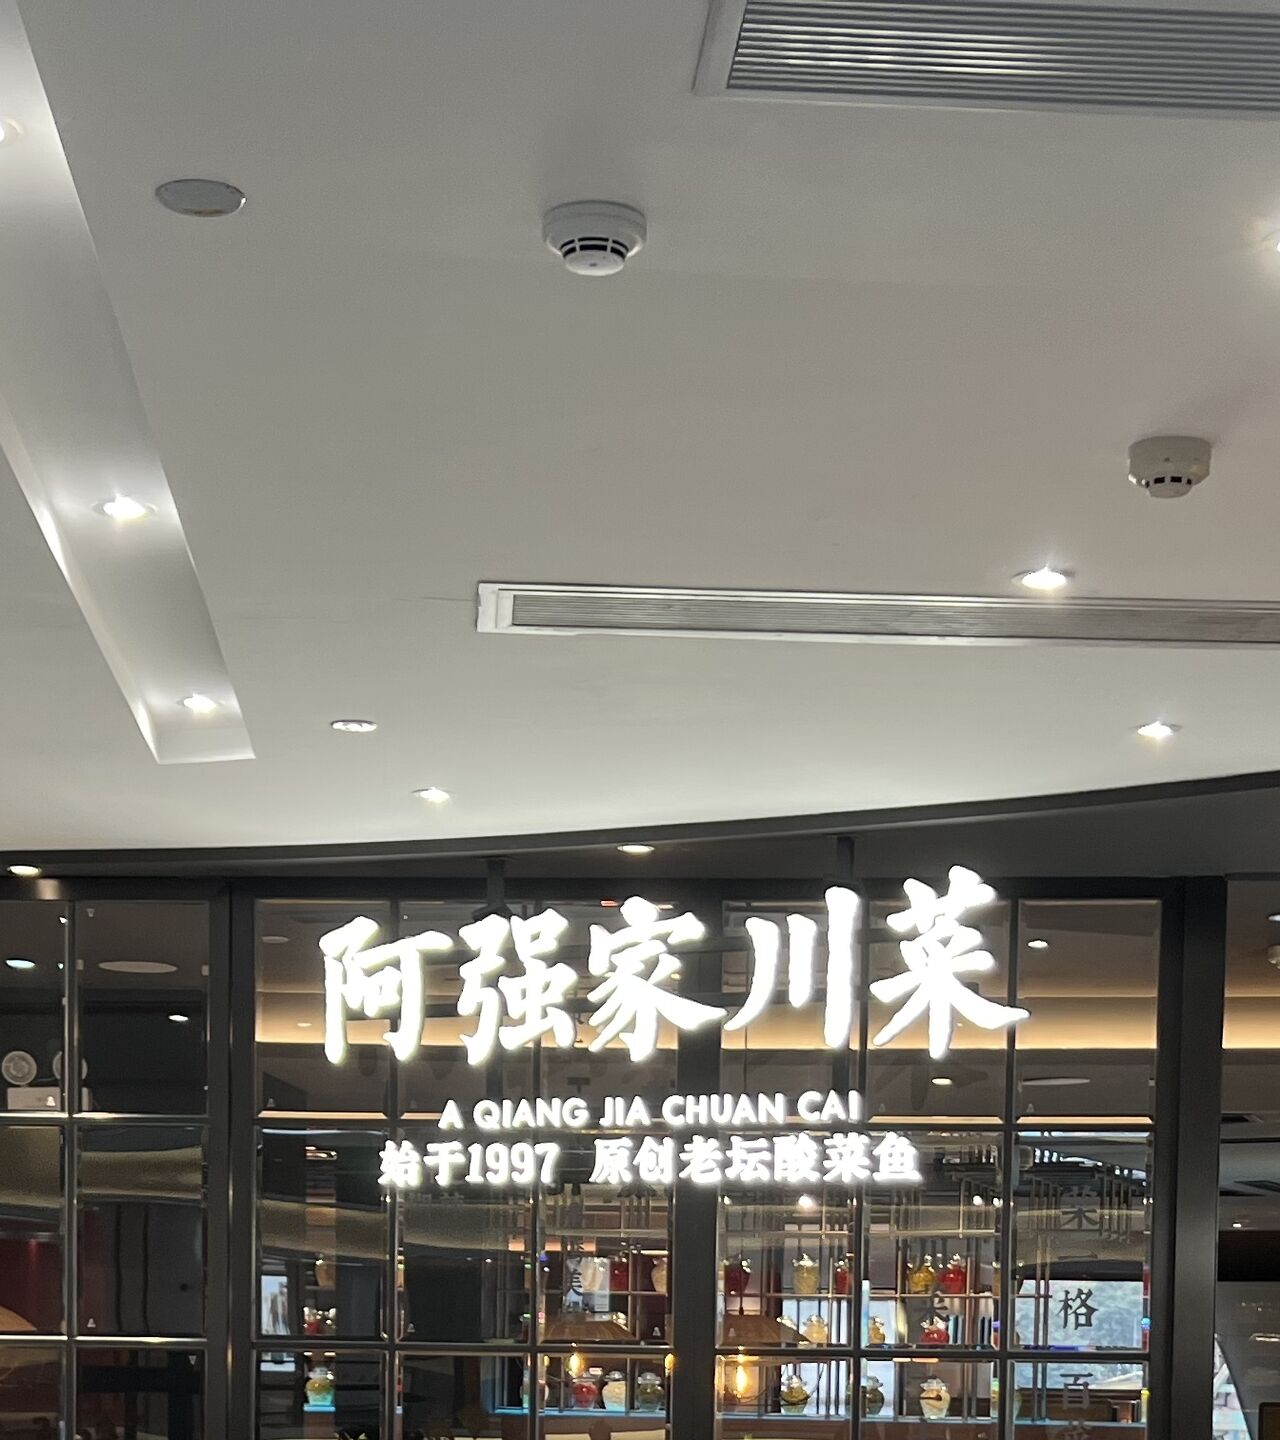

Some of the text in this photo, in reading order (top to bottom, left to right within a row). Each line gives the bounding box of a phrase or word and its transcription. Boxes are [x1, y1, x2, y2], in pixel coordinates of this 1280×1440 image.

[319, 864, 1031, 1065] 阿强家川菜
[436, 1090, 862, 1130] A QIANG JIA CHUAN CAI
[378, 1133, 923, 1188] 始于1997 原创老坛酸菜鱼
